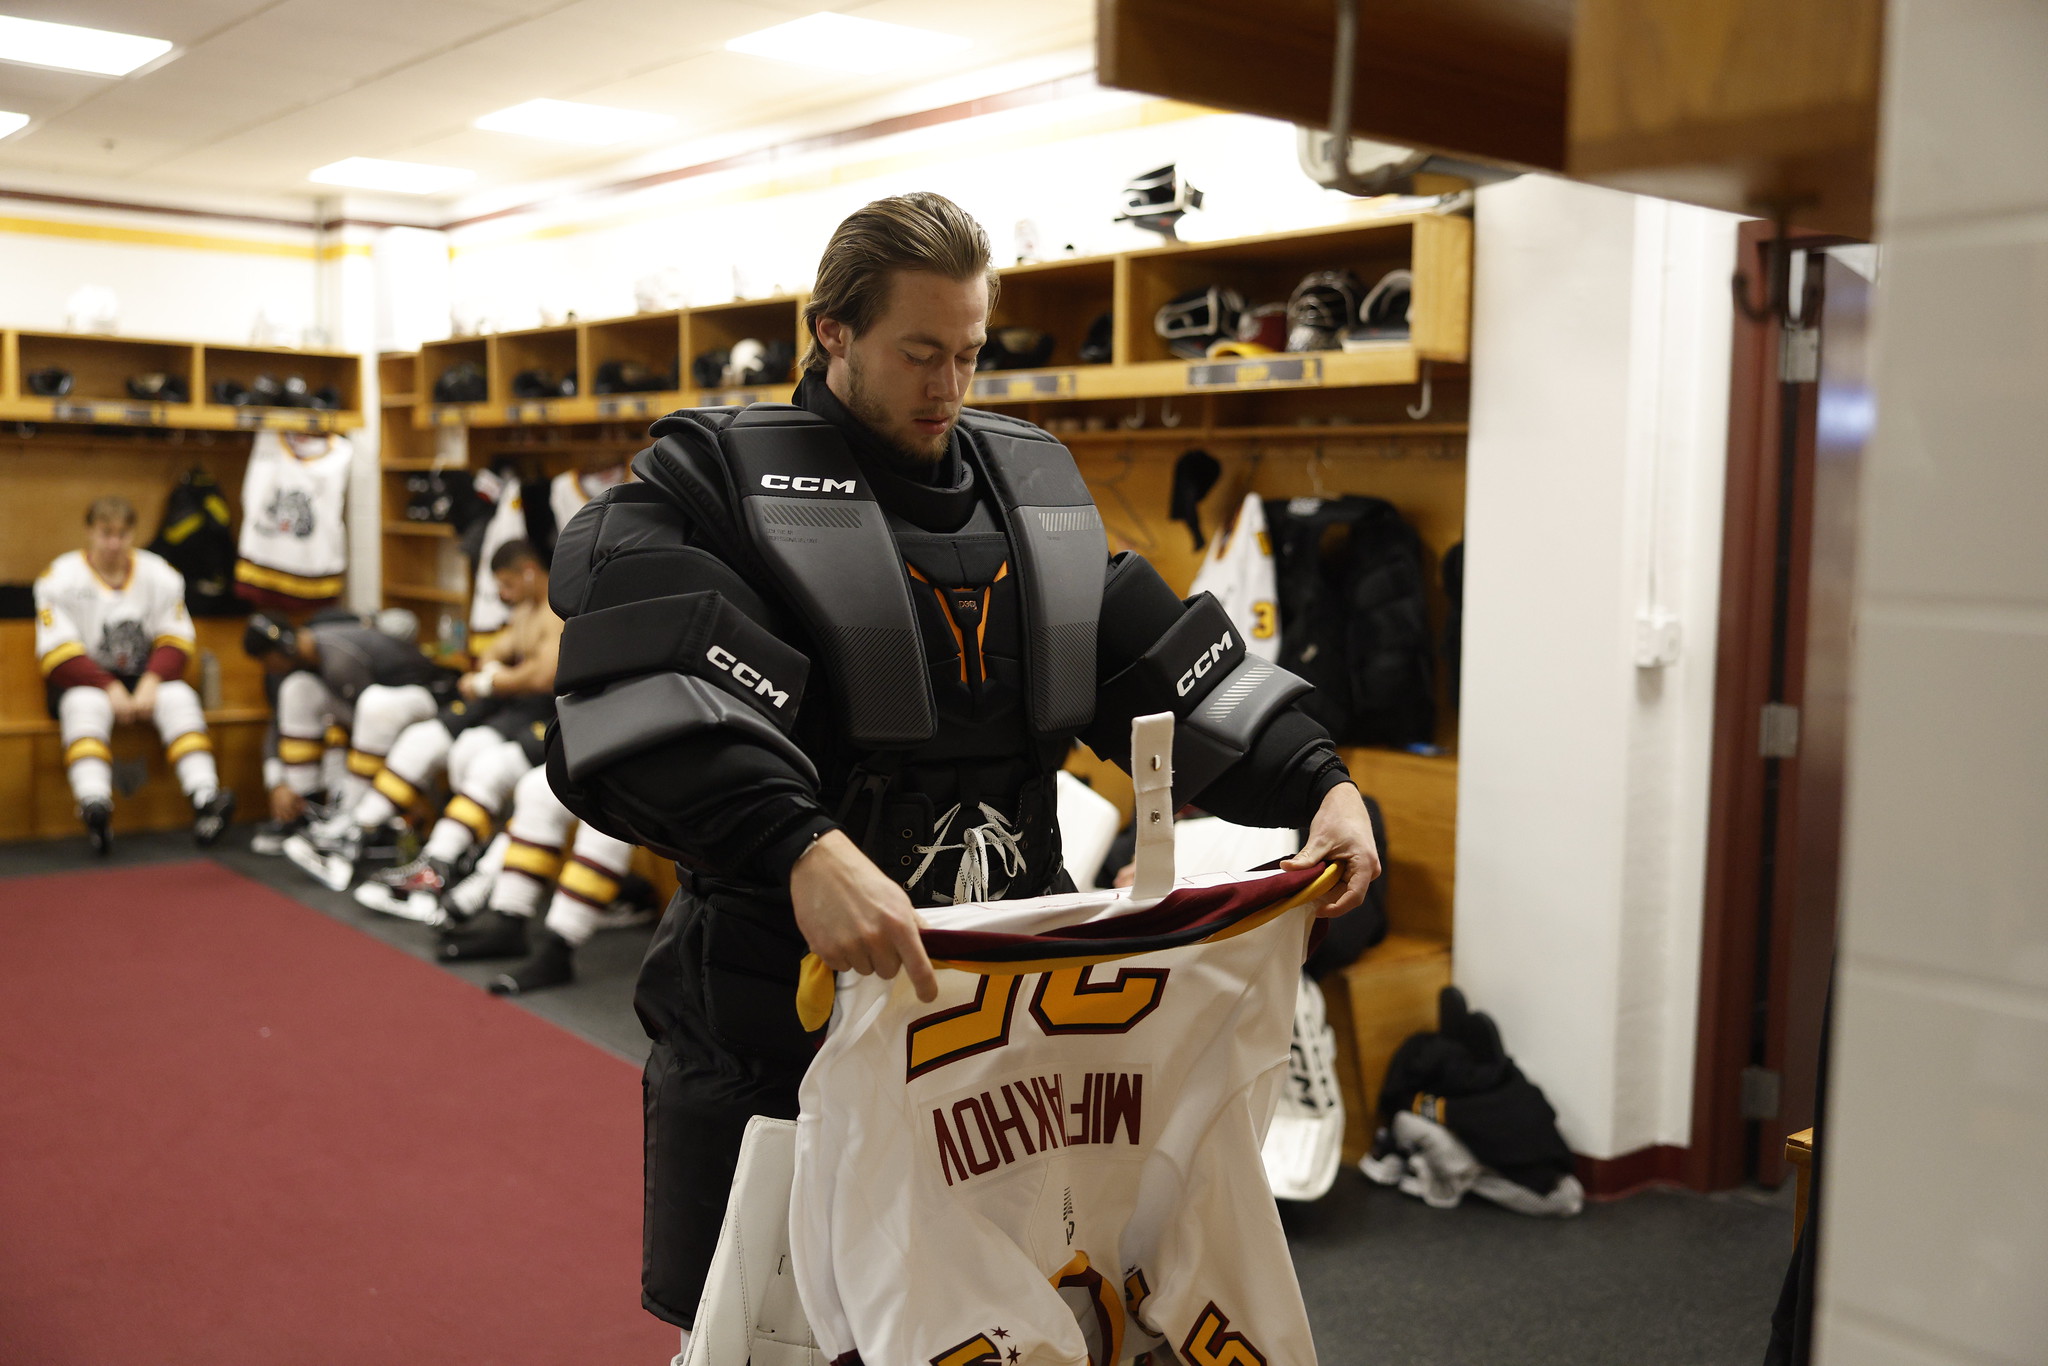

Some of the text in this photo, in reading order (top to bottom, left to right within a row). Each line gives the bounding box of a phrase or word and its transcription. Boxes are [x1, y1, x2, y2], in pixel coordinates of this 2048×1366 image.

[761, 474, 857, 494] CCM
[706, 645, 790, 709] CCM
[1176, 631, 1233, 697] CCM
